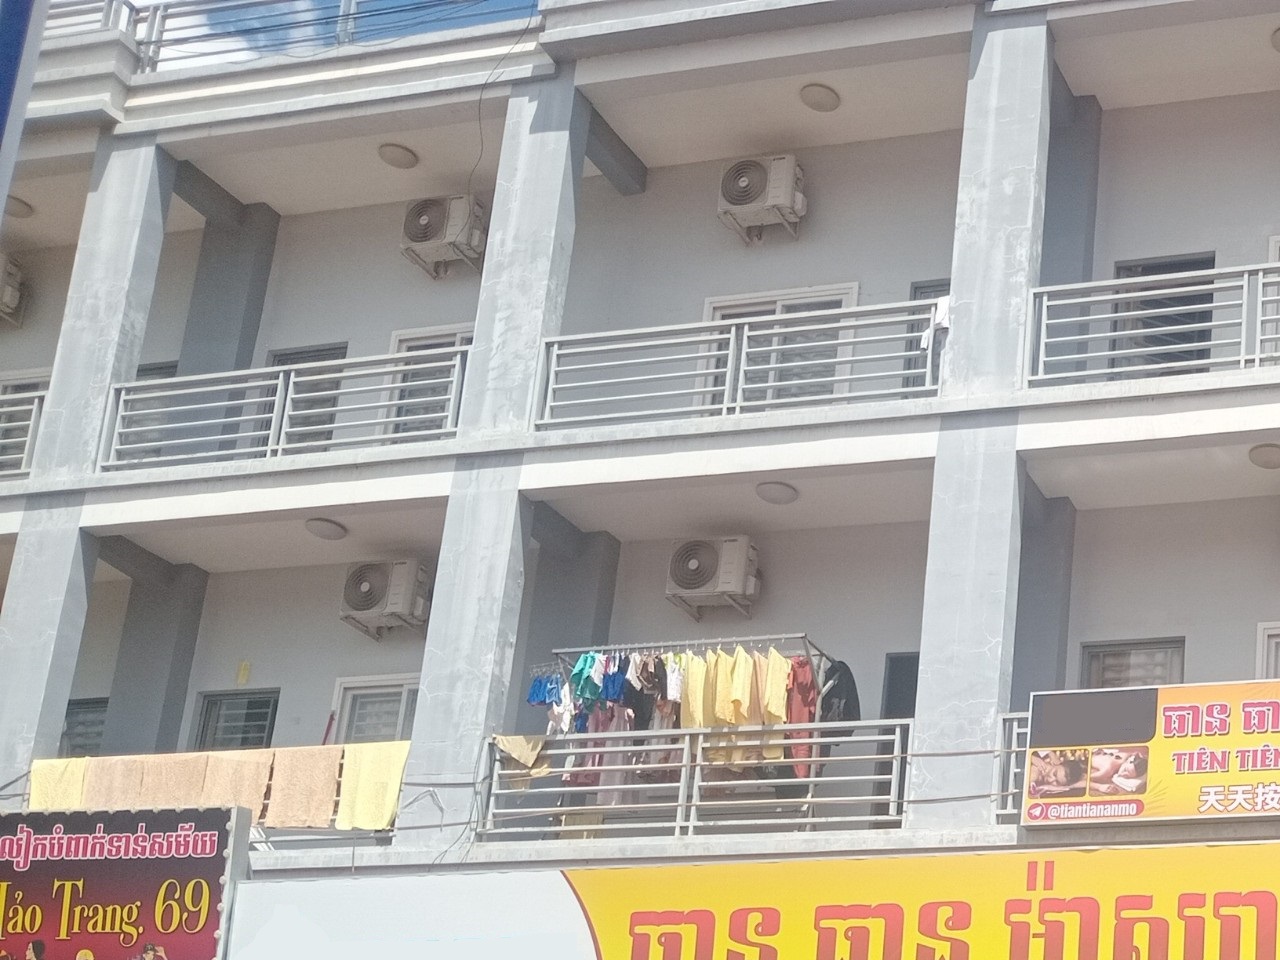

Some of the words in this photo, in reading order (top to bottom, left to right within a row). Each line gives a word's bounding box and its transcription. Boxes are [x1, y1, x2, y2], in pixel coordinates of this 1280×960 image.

[1172, 745, 1230, 774] TIÊN
[1047, 801, 1137, 820] @tiantiananmo
[154, 878, 211, 934] 69
